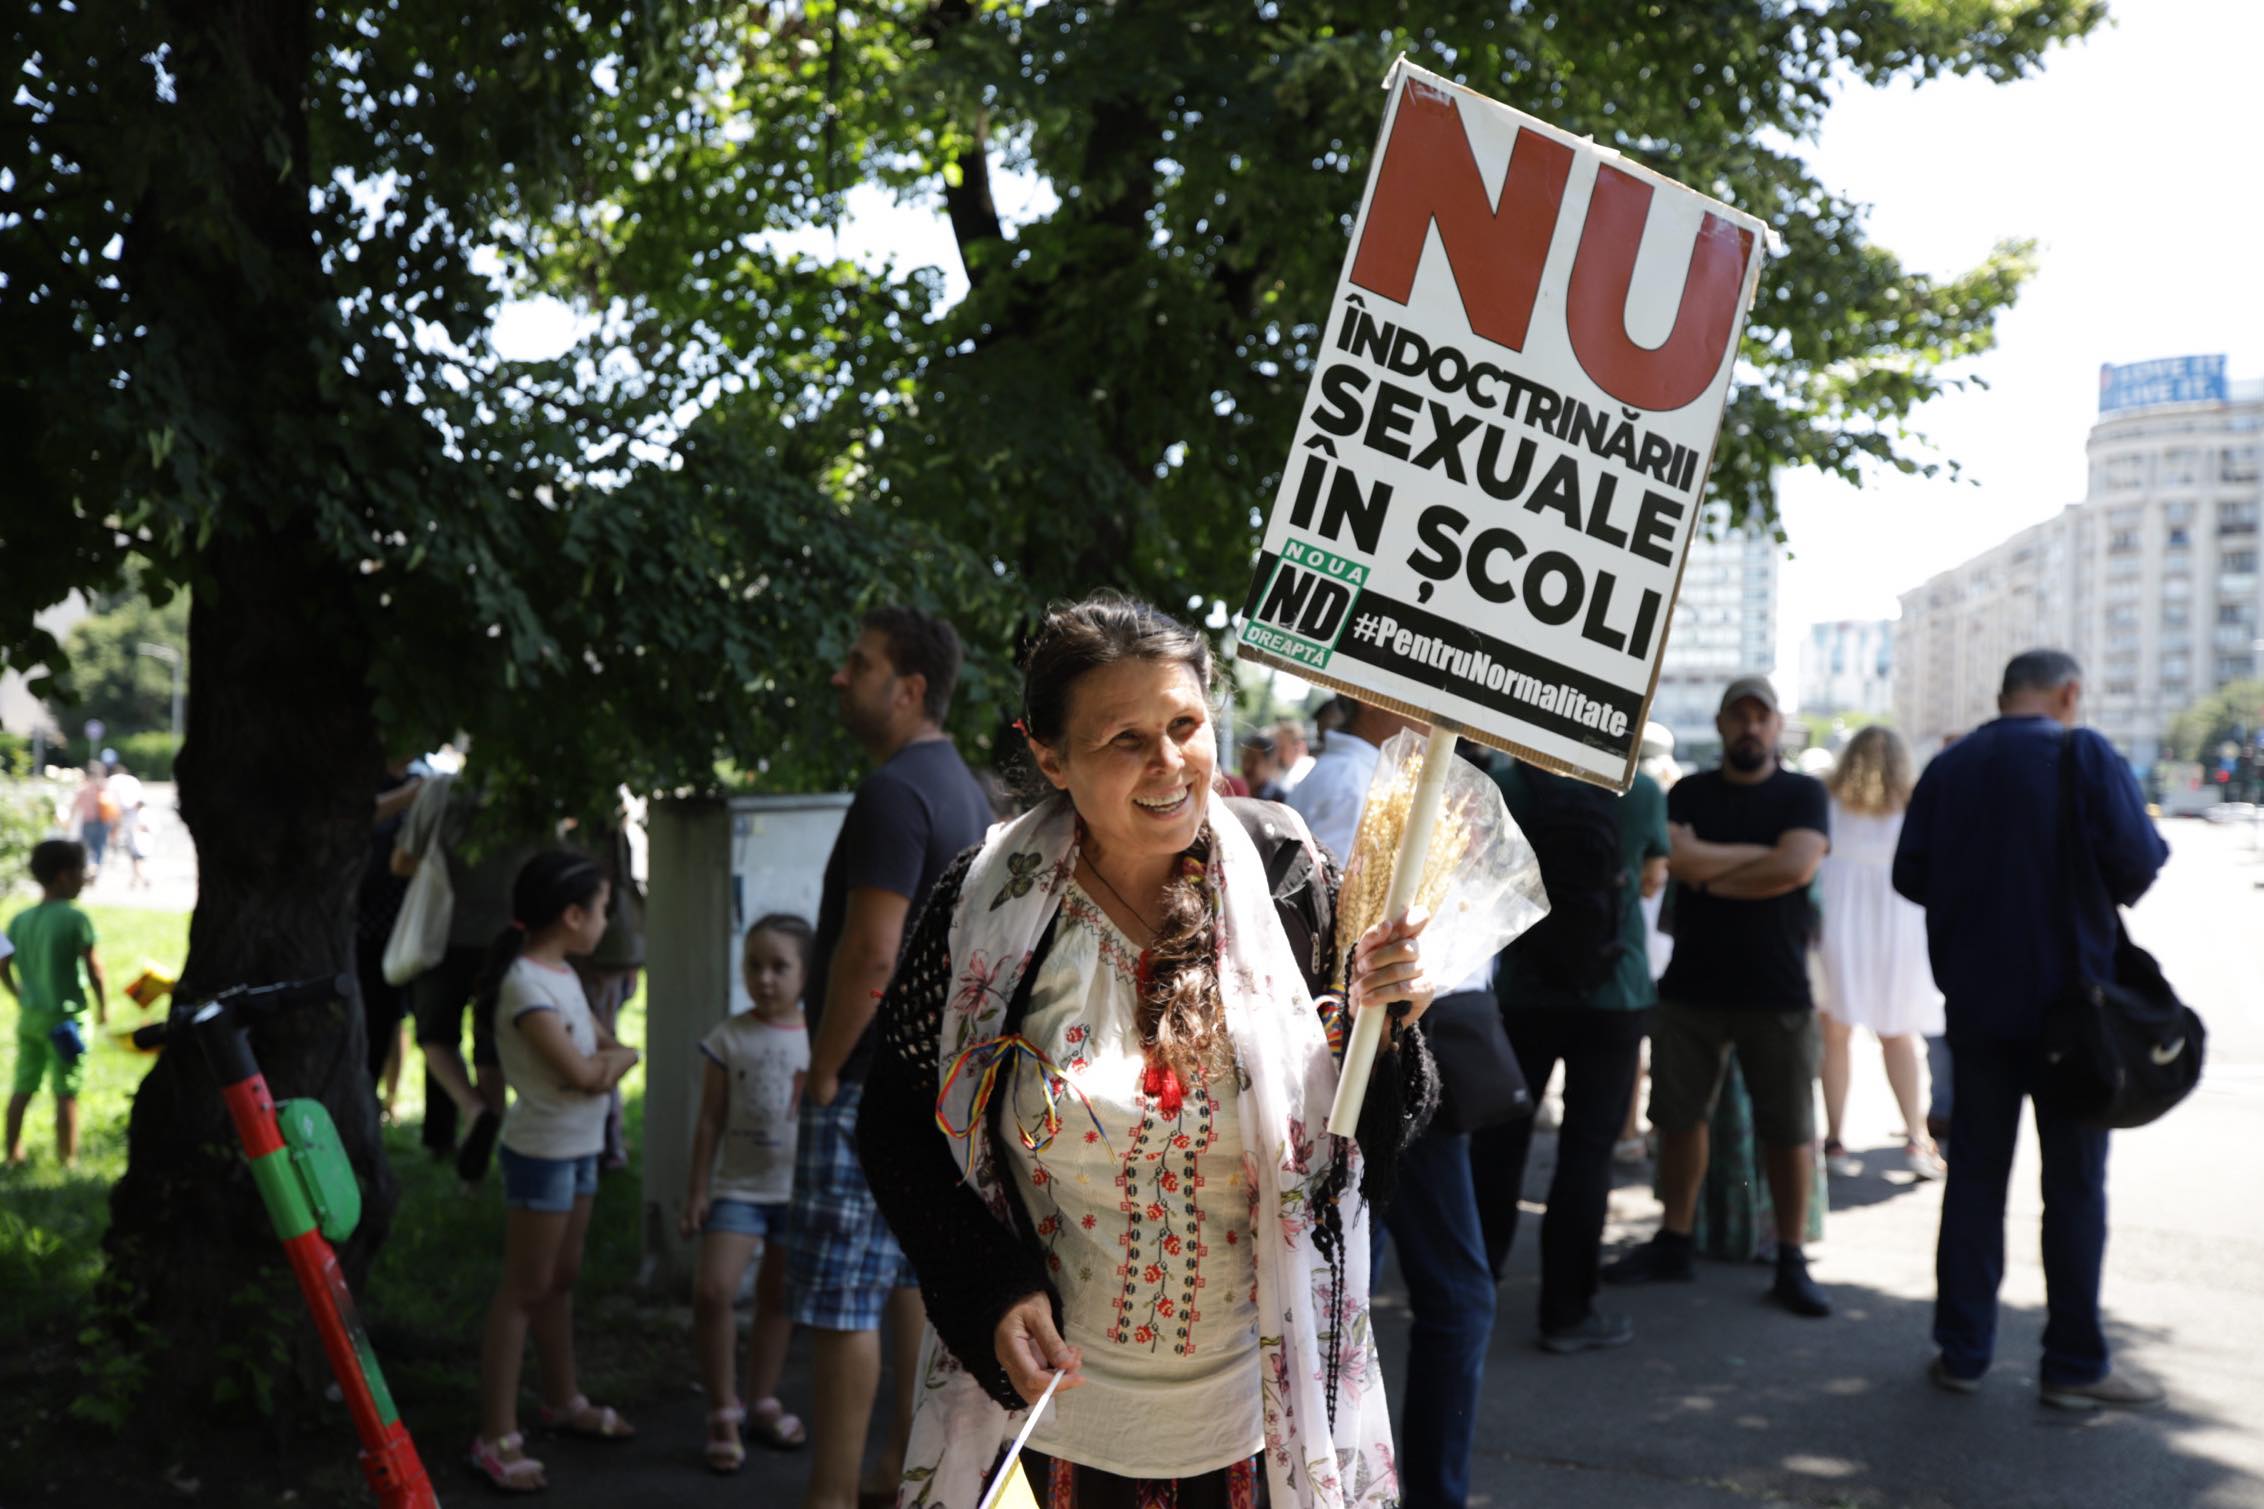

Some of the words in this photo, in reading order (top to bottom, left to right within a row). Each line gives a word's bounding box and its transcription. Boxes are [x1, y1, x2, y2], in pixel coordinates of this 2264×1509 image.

[1349, 76, 1755, 411] NU
[1311, 364, 1685, 567] SEXUALE
[1337, 293, 1699, 493] ÎNDOCTRINĂRII
[1258, 563, 1351, 642] ND
[1285, 542, 1363, 583] NOUA
[1290, 434, 1394, 555] ÎN
[1406, 505, 1662, 660] ȘCOLI
[1246, 626, 1326, 666] DREAPTĂ
[1353, 612, 1629, 737] #PentruNormalitate
